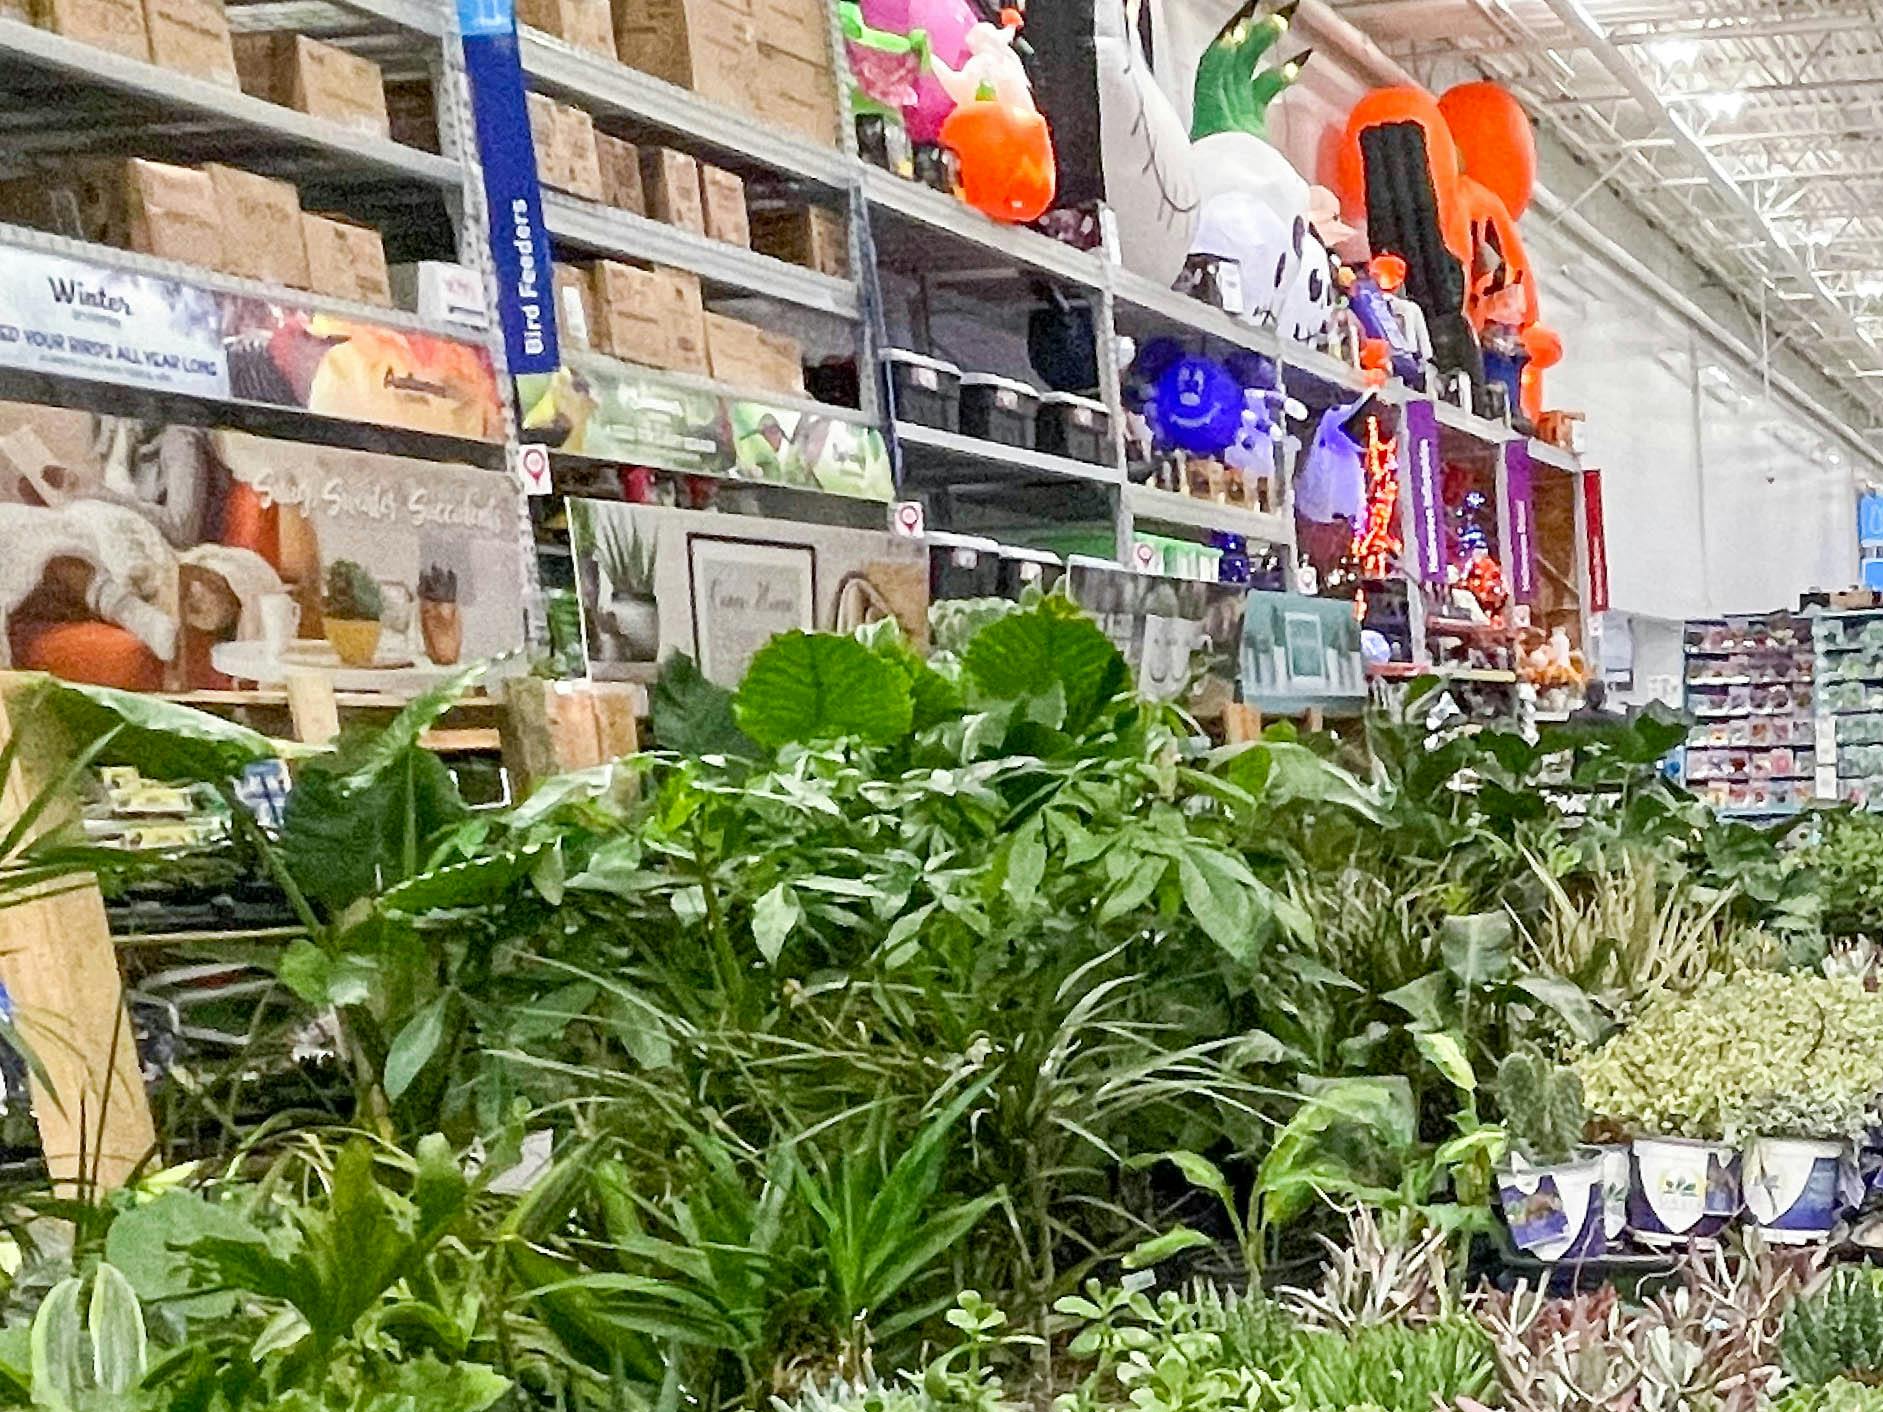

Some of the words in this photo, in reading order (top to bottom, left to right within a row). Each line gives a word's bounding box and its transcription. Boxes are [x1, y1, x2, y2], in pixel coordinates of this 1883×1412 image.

[512, 198, 538, 298] Feeders
[48, 276, 132, 316] Winter
[23, 330, 65, 349] YOUR
[116, 347, 142, 364] ALL
[143, 352, 180, 369] YEAR
[182, 358, 217, 376] LONG
[520, 304, 544, 355] Bird
